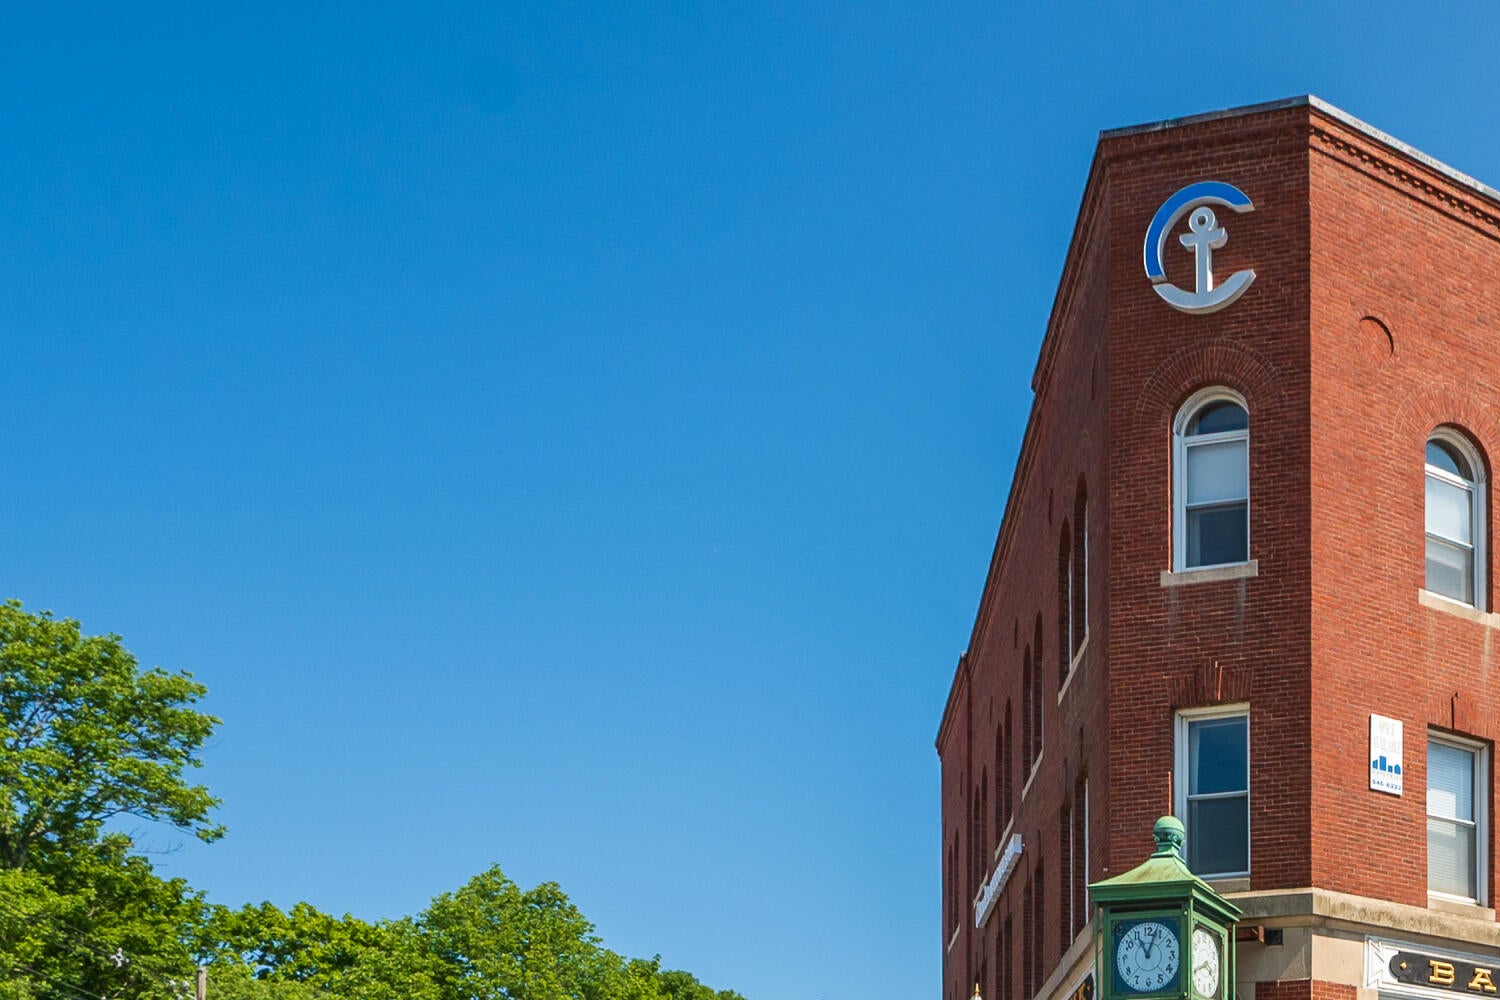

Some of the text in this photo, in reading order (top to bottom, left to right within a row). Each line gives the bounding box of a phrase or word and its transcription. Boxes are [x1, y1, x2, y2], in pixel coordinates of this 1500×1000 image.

[1165, 938, 1173, 948] 2
[1168, 950, 1176, 961] 3
[1157, 973, 1164, 984] 5
